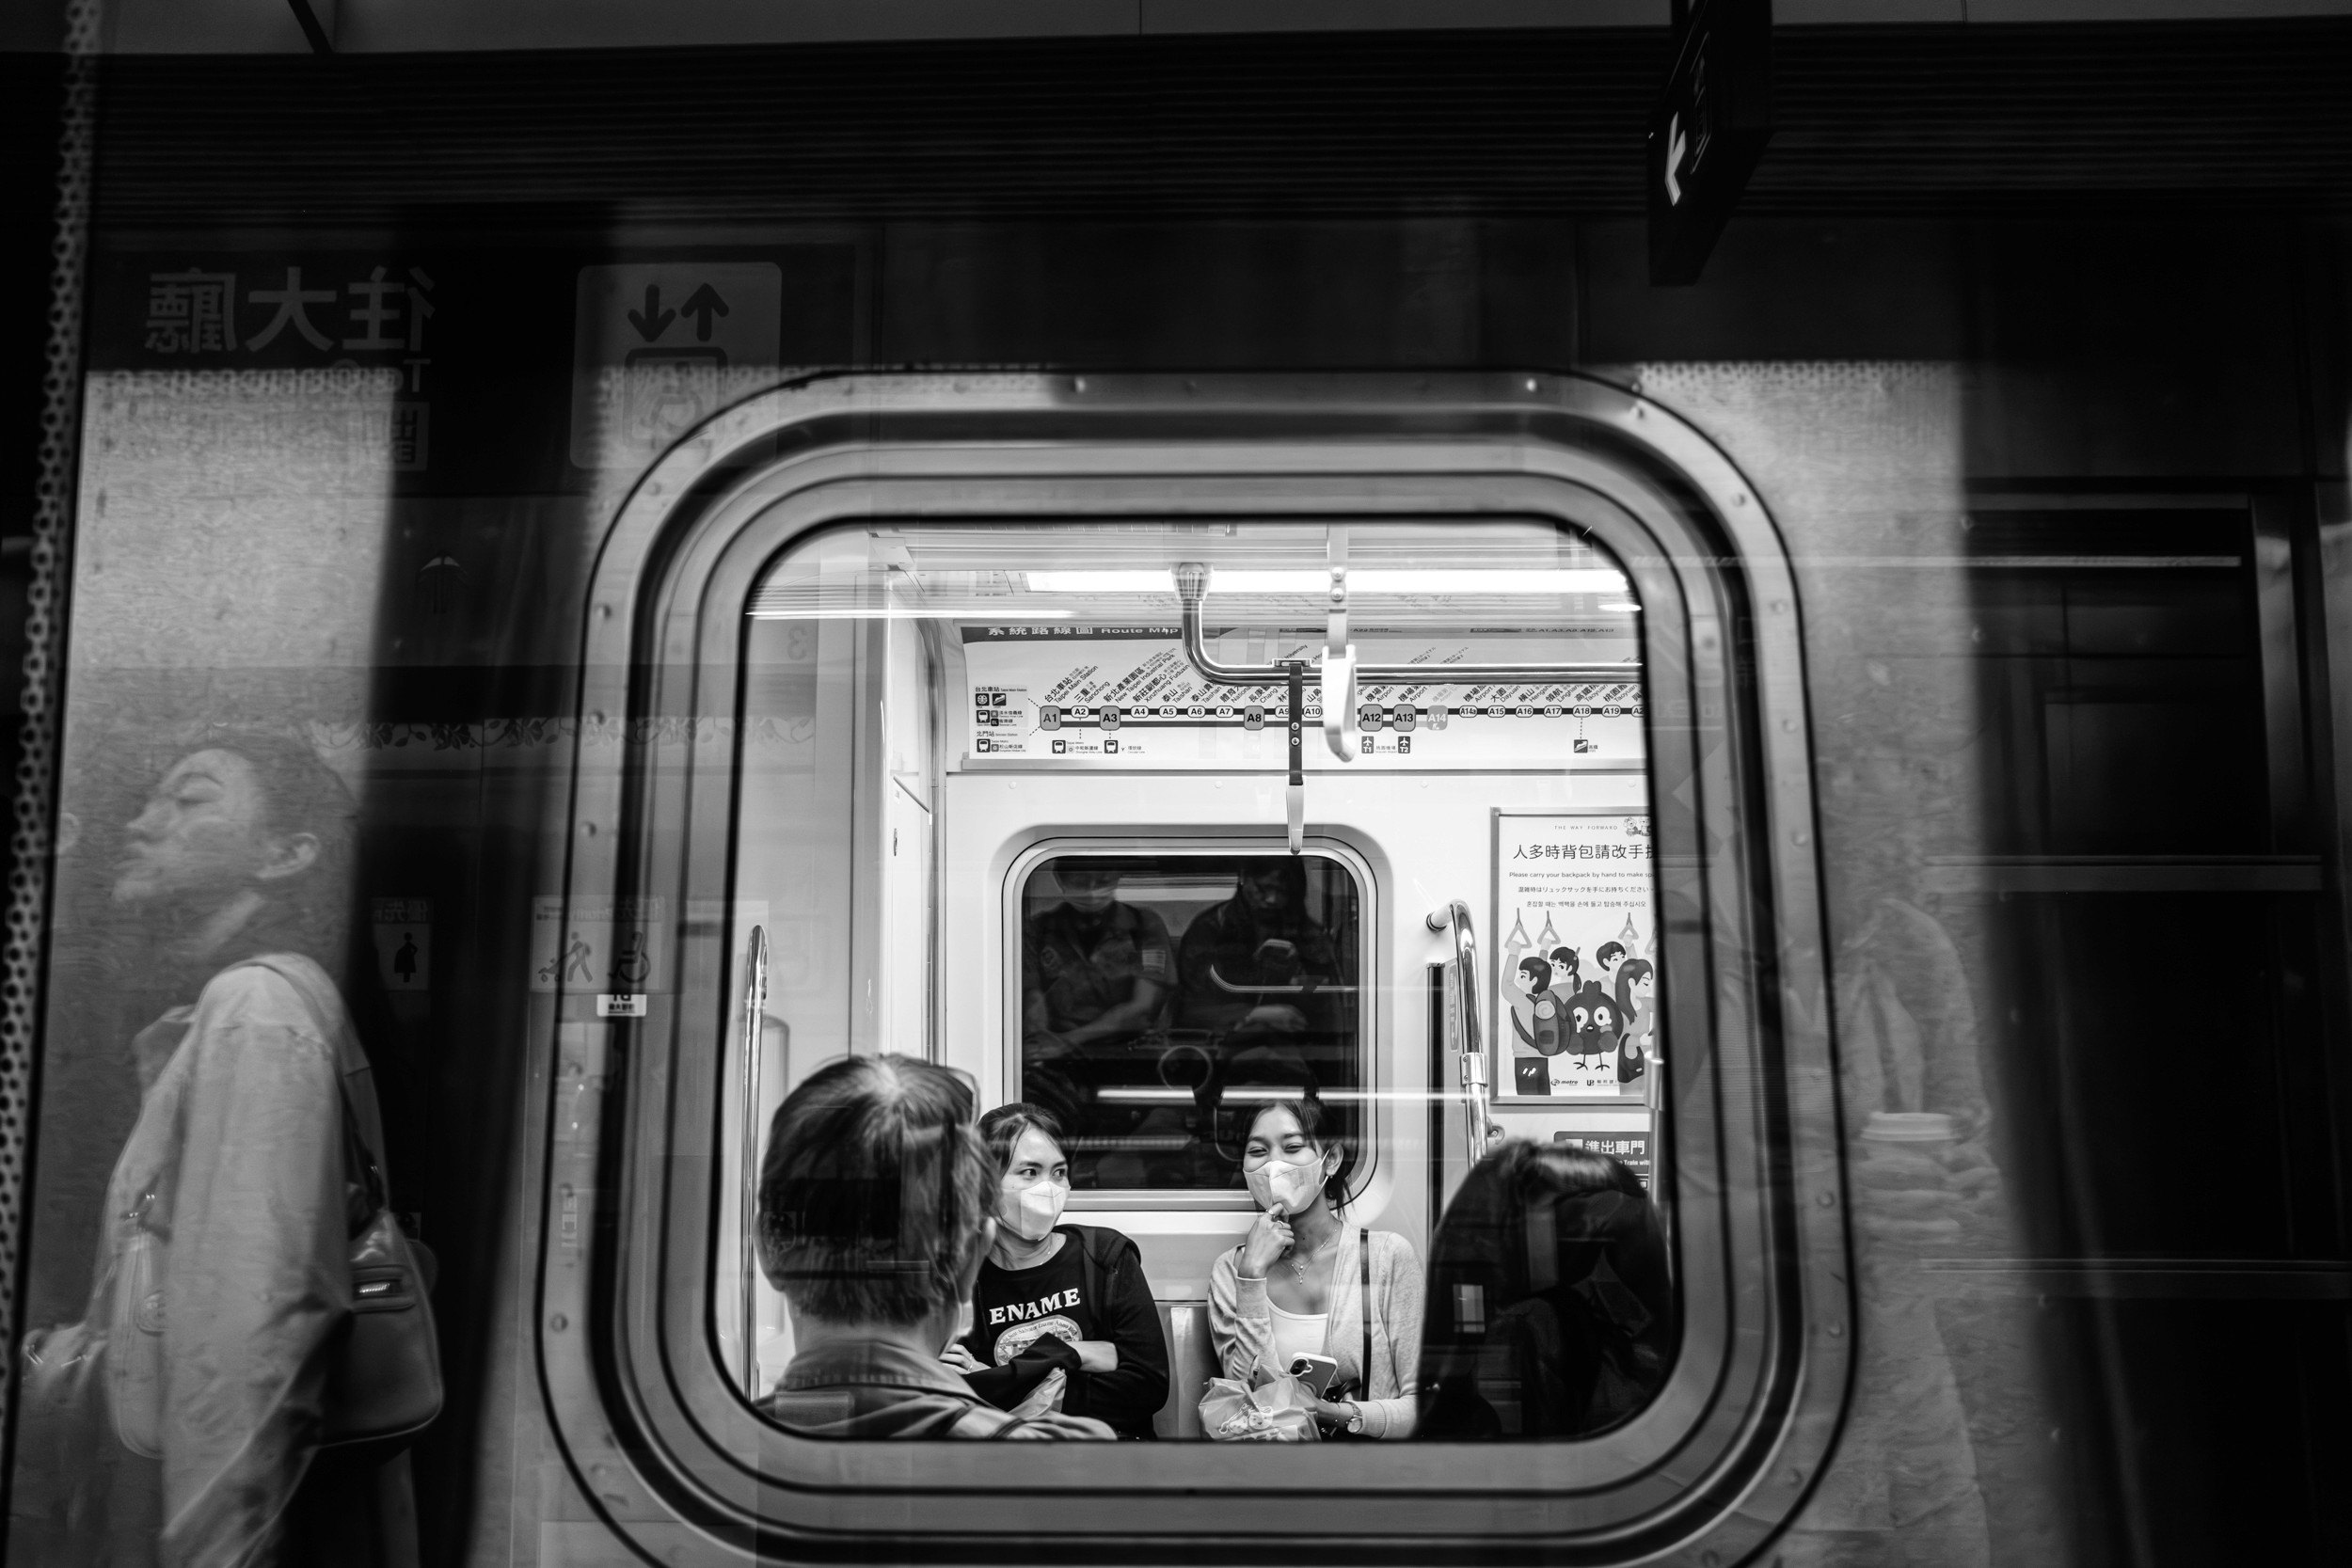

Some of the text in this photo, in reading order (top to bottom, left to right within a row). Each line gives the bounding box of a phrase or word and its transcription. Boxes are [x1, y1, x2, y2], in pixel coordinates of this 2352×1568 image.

[988, 627, 1093, 636] 系統路線圖
[1042, 674, 1073, 703] 台北車站
[1376, 687, 1394, 703] Airport
[1409, 687, 1427, 703] Airport
[1043, 714, 1057, 722] A1
[1103, 713, 1118, 722] A3
[1247, 713, 1262, 722] A8
[1362, 713, 1381, 722] A12
[1395, 713, 1413, 722] A13
[1428, 714, 1446, 722] A14
[1584, 1140, 1645, 1155] 進出車門
[989, 1288, 1081, 1325] ENAME
